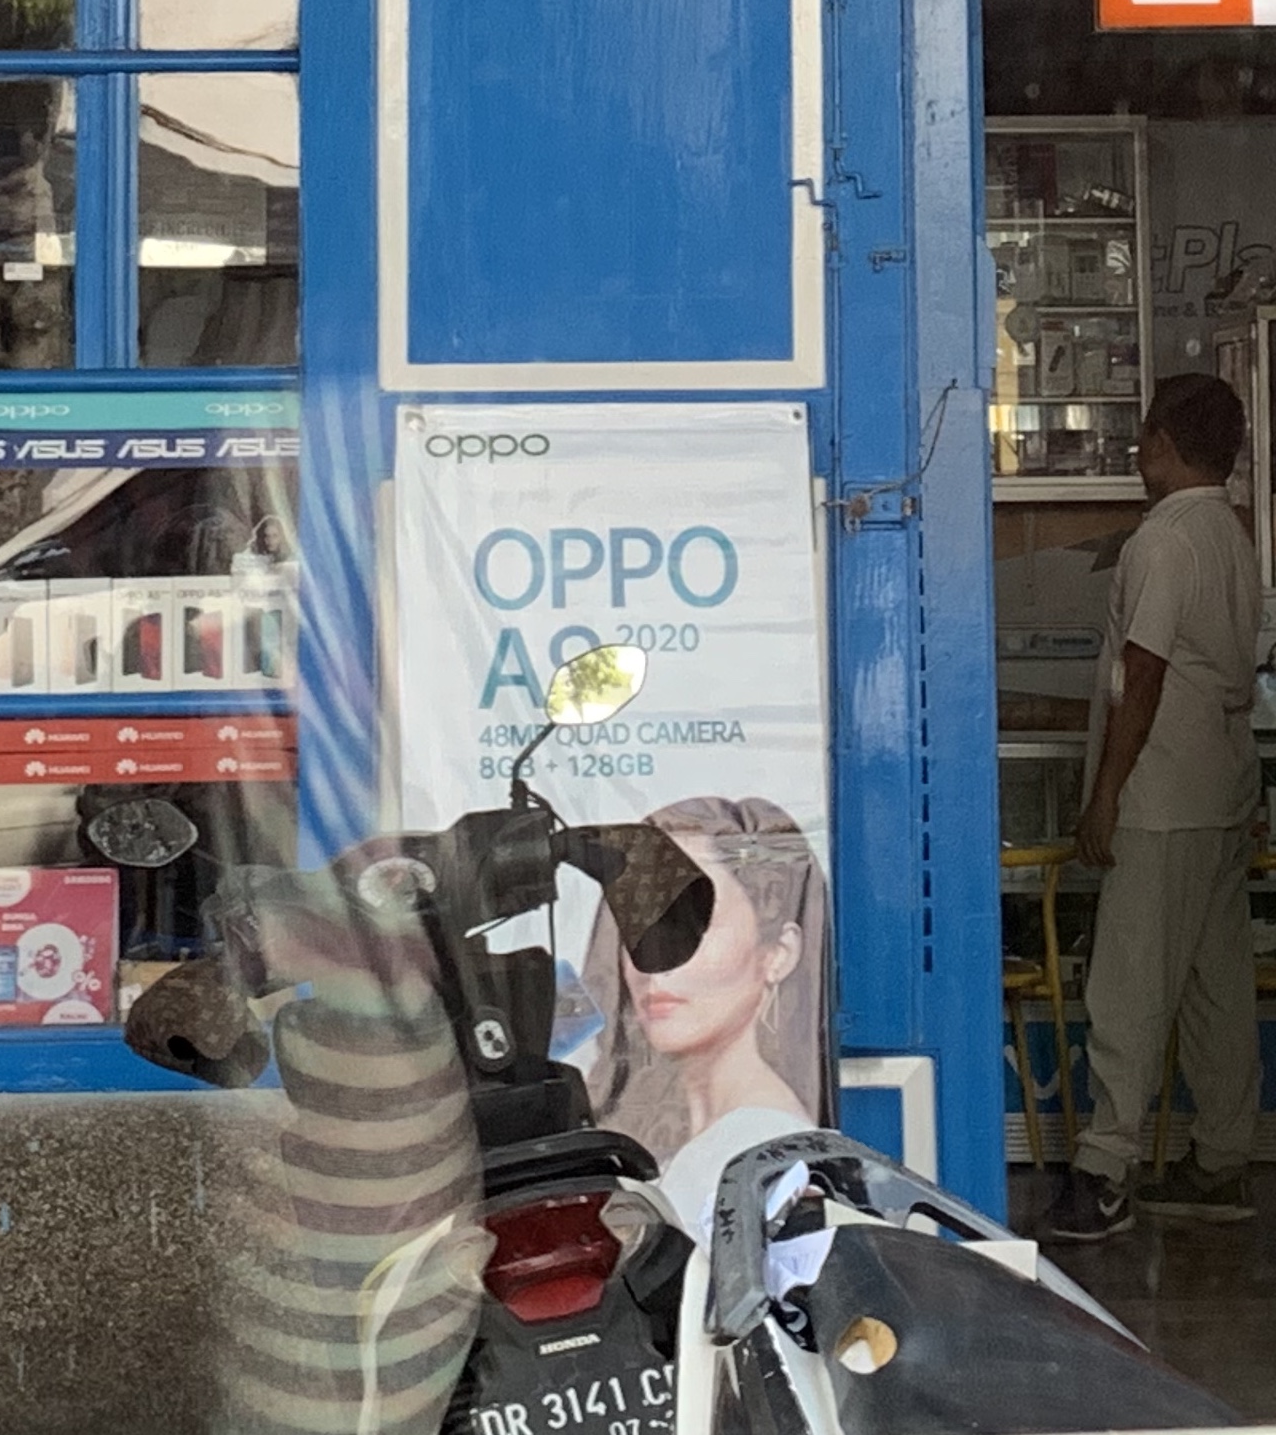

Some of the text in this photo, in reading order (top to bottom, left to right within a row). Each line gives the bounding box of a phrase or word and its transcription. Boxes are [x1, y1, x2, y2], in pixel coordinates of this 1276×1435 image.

[15, 439, 106, 460] ASUS
[117, 438, 206, 459] ASUS
[425, 433, 551, 464] oppo
[474, 525, 739, 611] OPPO
[555, 722, 630, 747] QUAD
[637, 720, 746, 745] CAMERA
[567, 754, 655, 778] 128GB
[539, 1333, 601, 1355] HONDA
[542, 1376, 626, 1430] 3141
